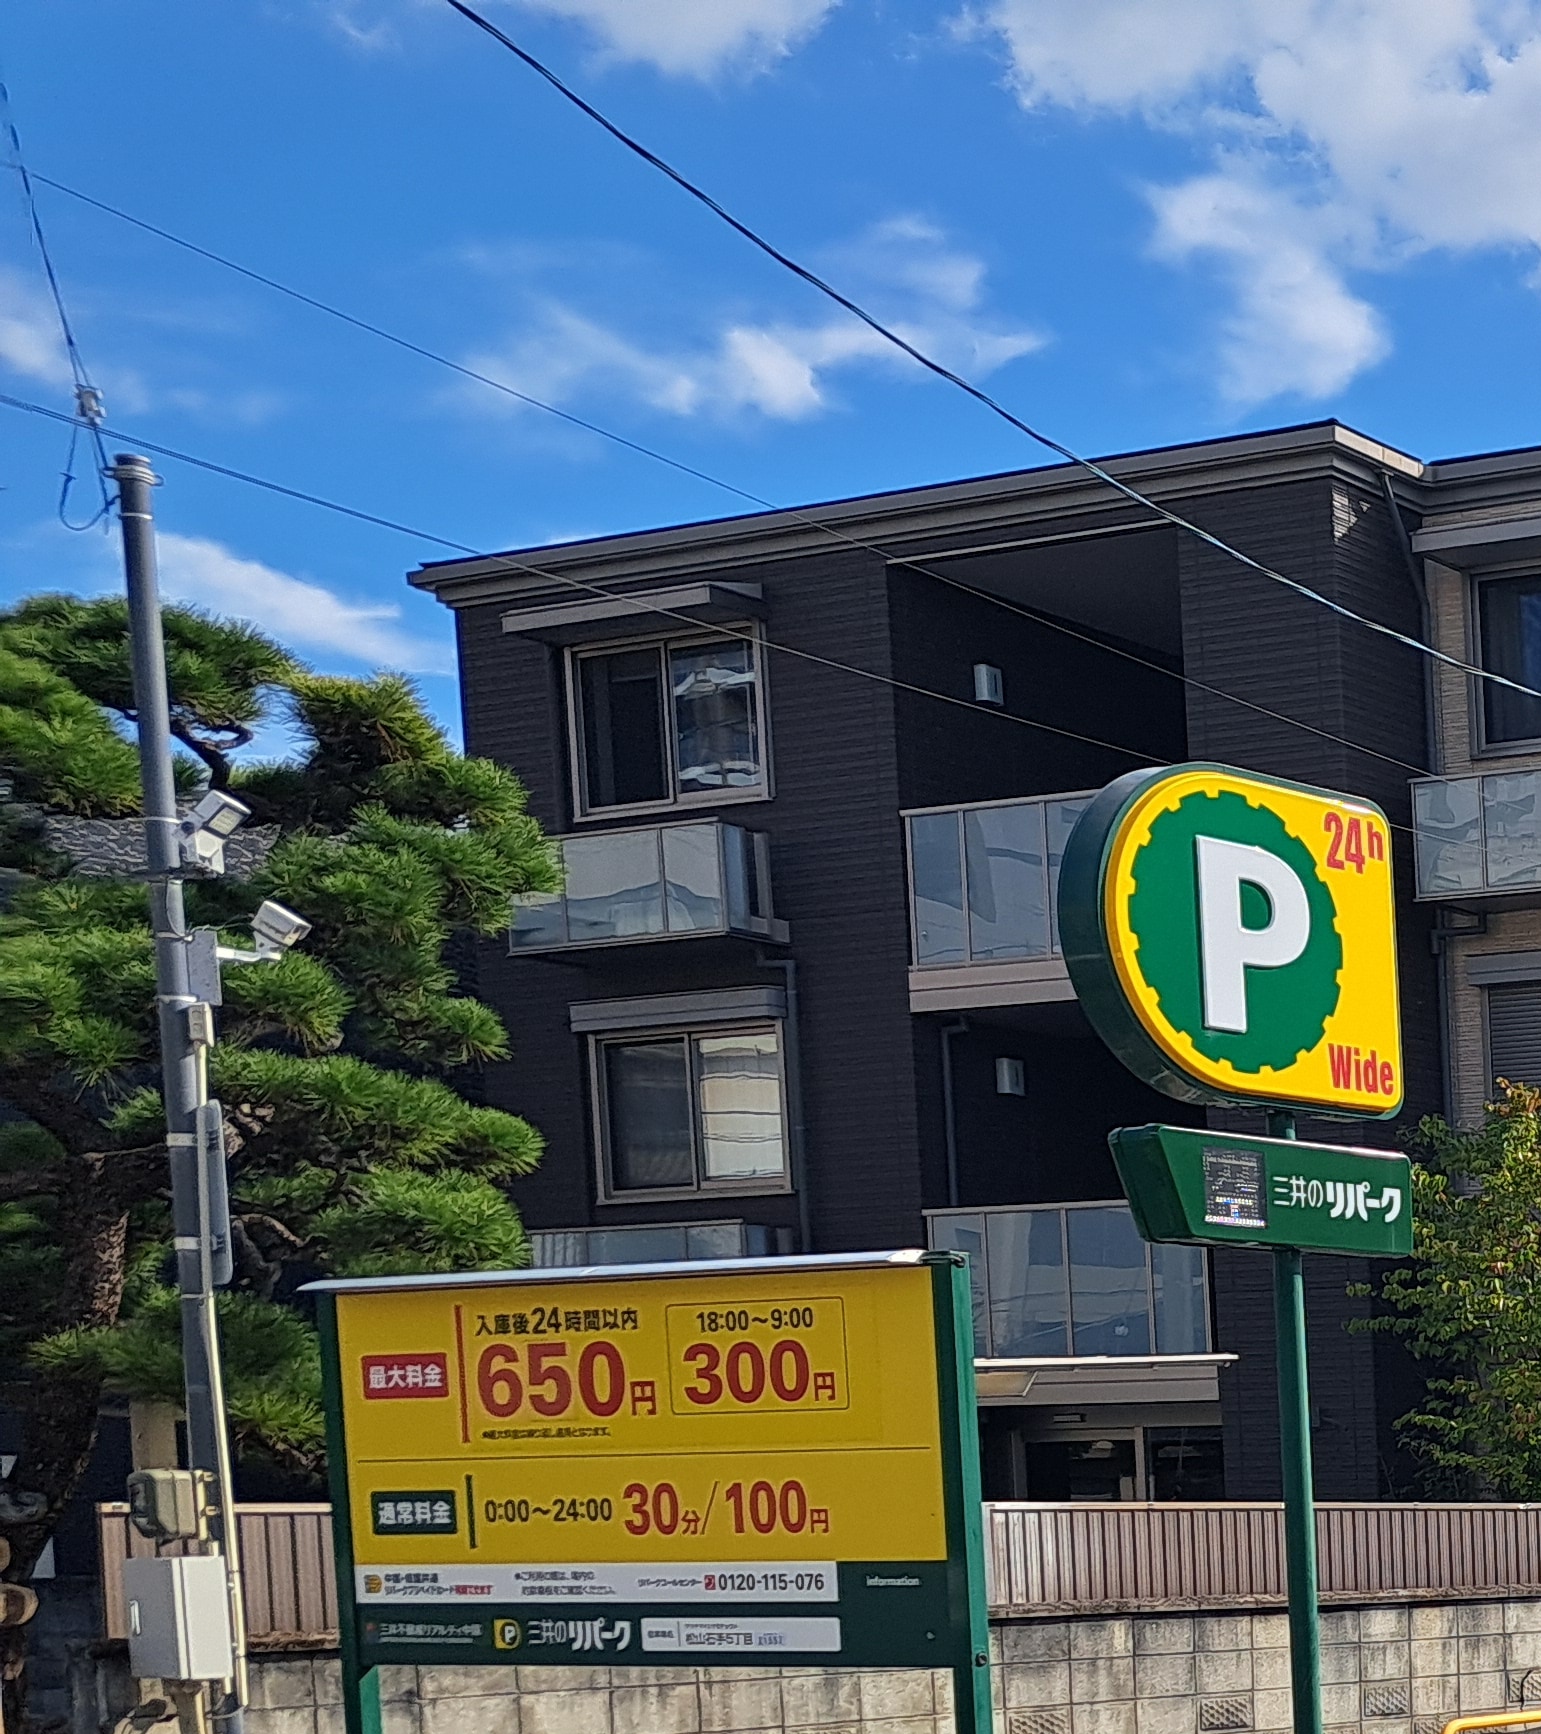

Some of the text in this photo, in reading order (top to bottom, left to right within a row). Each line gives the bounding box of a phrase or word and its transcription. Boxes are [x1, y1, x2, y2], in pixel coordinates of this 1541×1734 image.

[1325, 812, 1383, 874] 24h
[1196, 834, 1310, 1034] P
[1328, 1044, 1395, 1095] Wide
[1273, 1176, 1402, 1222] 三井のリパーク
[475, 1307, 639, 1337] 入庫後24時間以内
[368, 1363, 443, 1389] 最大料金
[378, 1501, 451, 1524] 通常料金
[718, 1573, 825, 1591] 0120-115-076
[528, 1616, 632, 1651] 三井のリパーク
